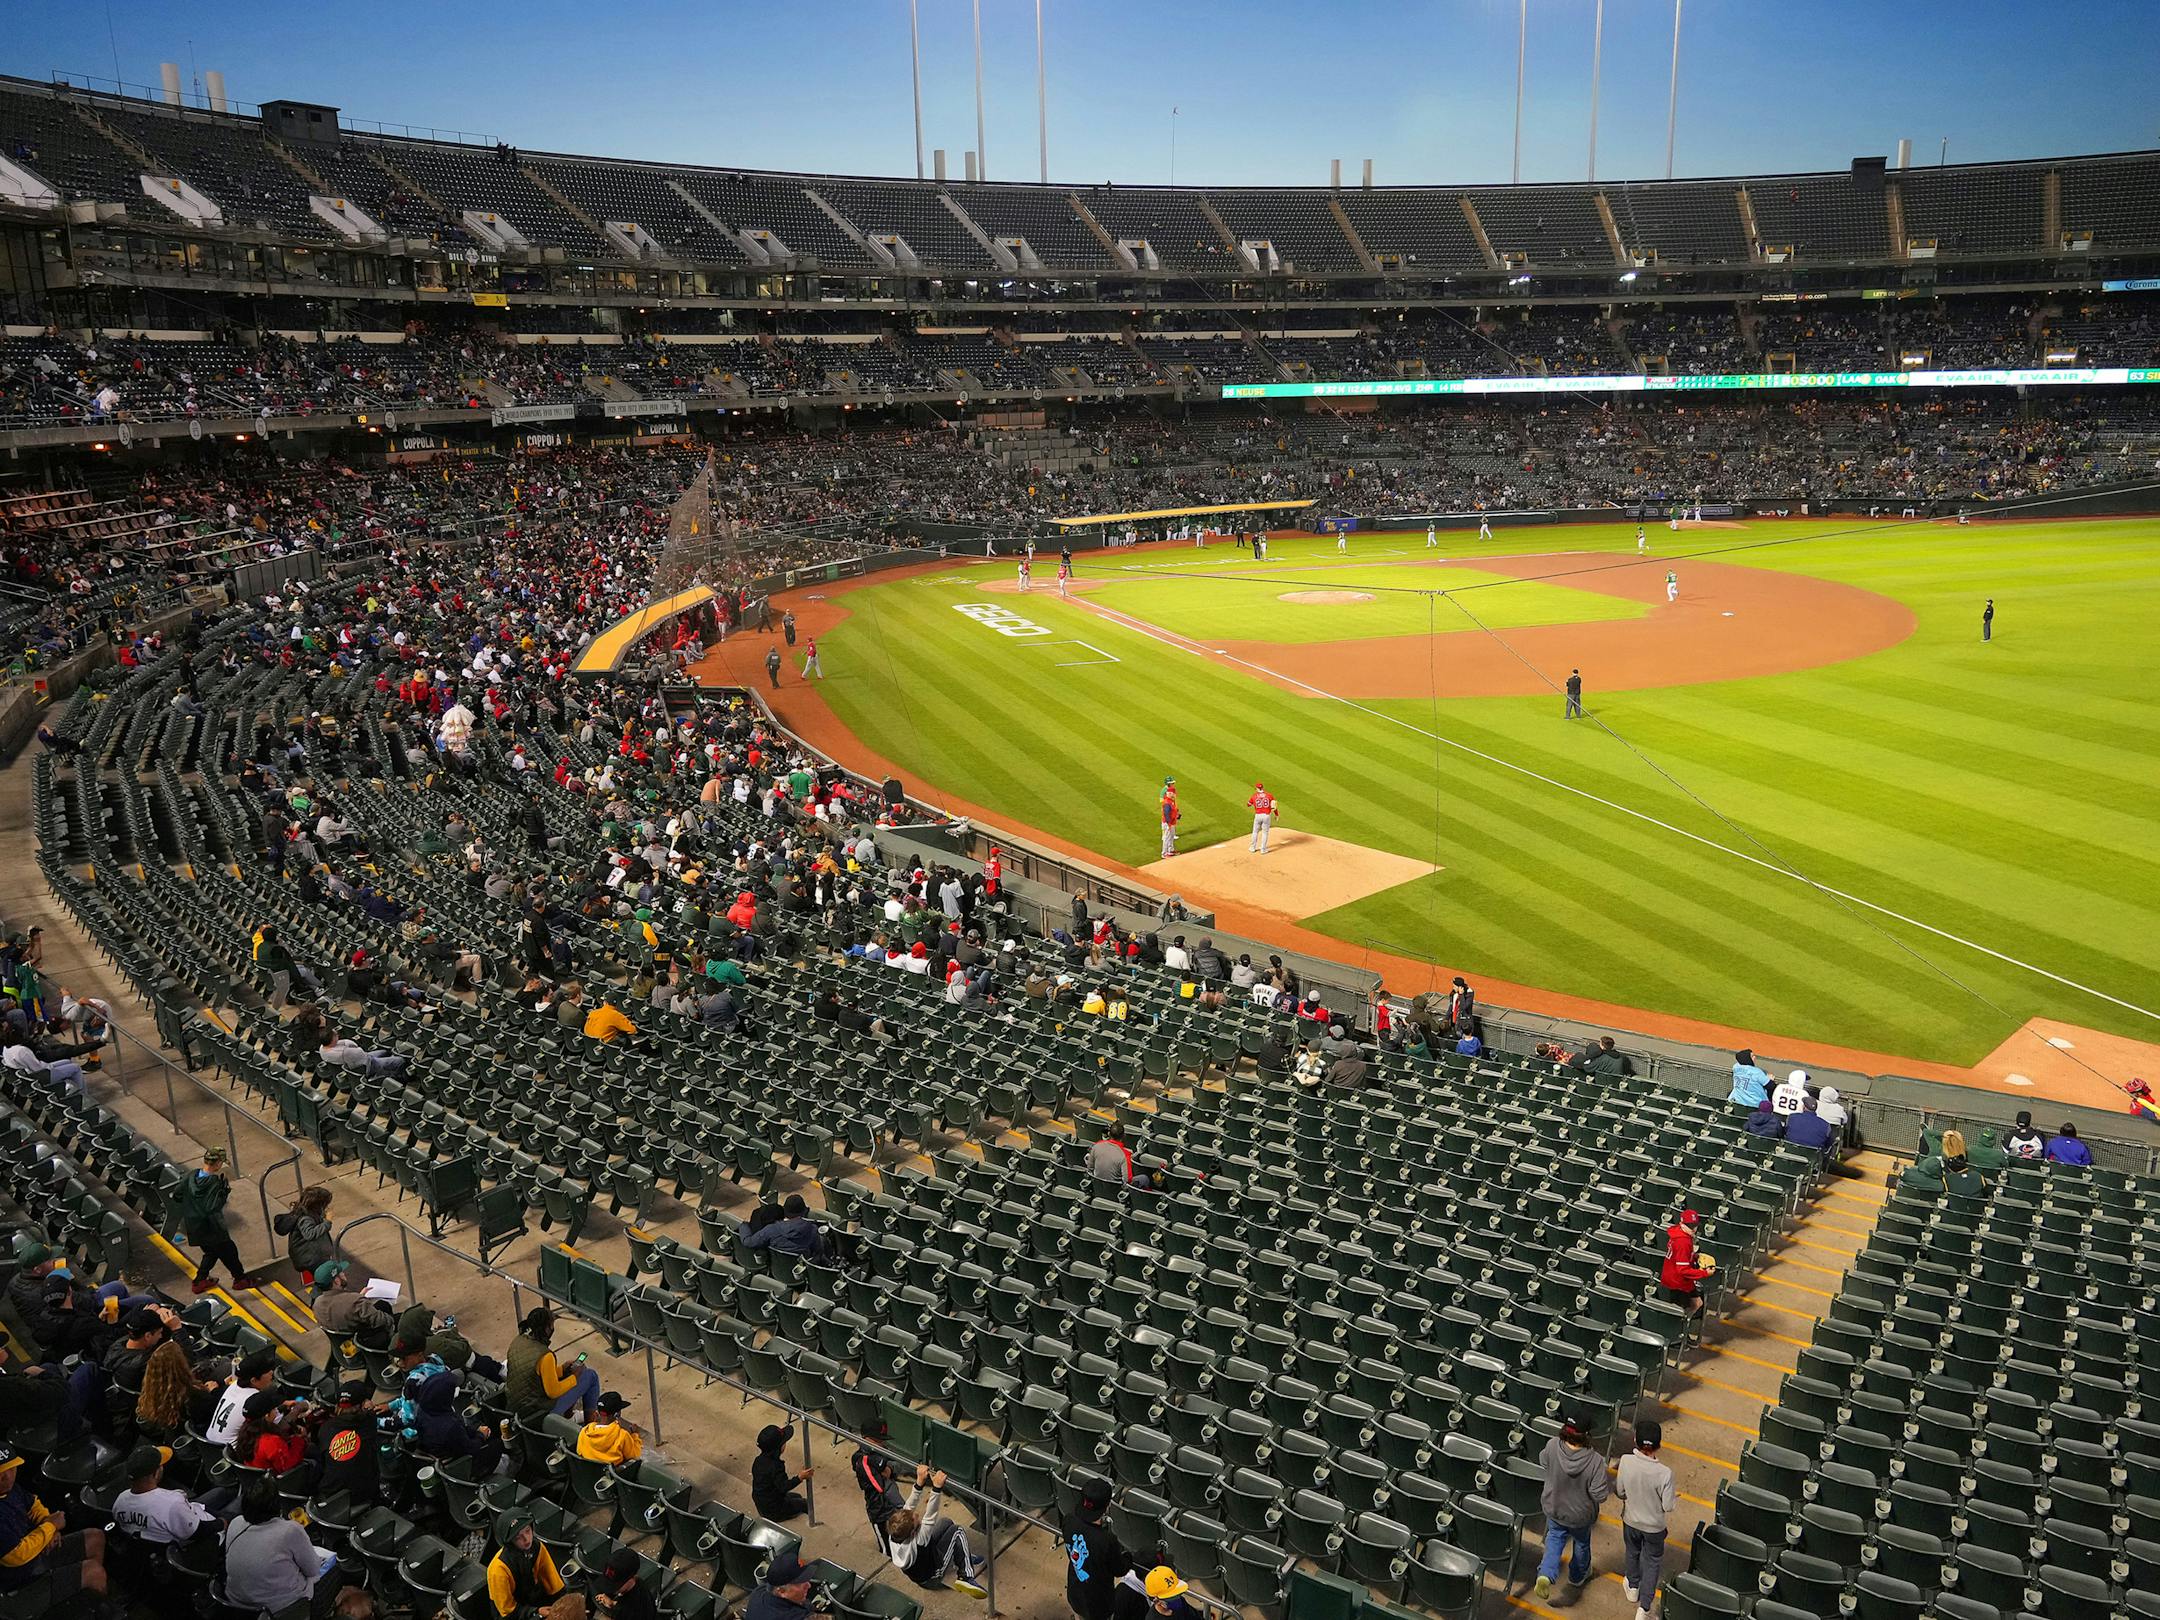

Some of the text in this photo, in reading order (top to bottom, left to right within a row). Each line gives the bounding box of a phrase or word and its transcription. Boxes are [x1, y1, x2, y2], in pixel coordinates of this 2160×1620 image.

[449, 253, 497, 263] BILL KING
[2125, 280, 2158, 289] Corona
[1875, 375, 1897, 384] OAK
[1936, 374, 1964, 382] EVA
[2019, 373, 2049, 381] EVA
[2130, 372, 2144, 380] 63
[520, 409, 541, 418] CHAMPIONS
[650, 424, 678, 434] COPPOLA
[403, 437, 435, 450] COPPOLA
[527, 434, 562, 447] COPPOLA
[952, 603, 1052, 637] GEICO
[1256, 799, 1269, 808] 28
[1778, 1096, 1798, 1111] 28
[211, 1398, 236, 1433] 14
[328, 1430, 356, 1454] SANTA
[333, 1439, 358, 1461] CRUZ
